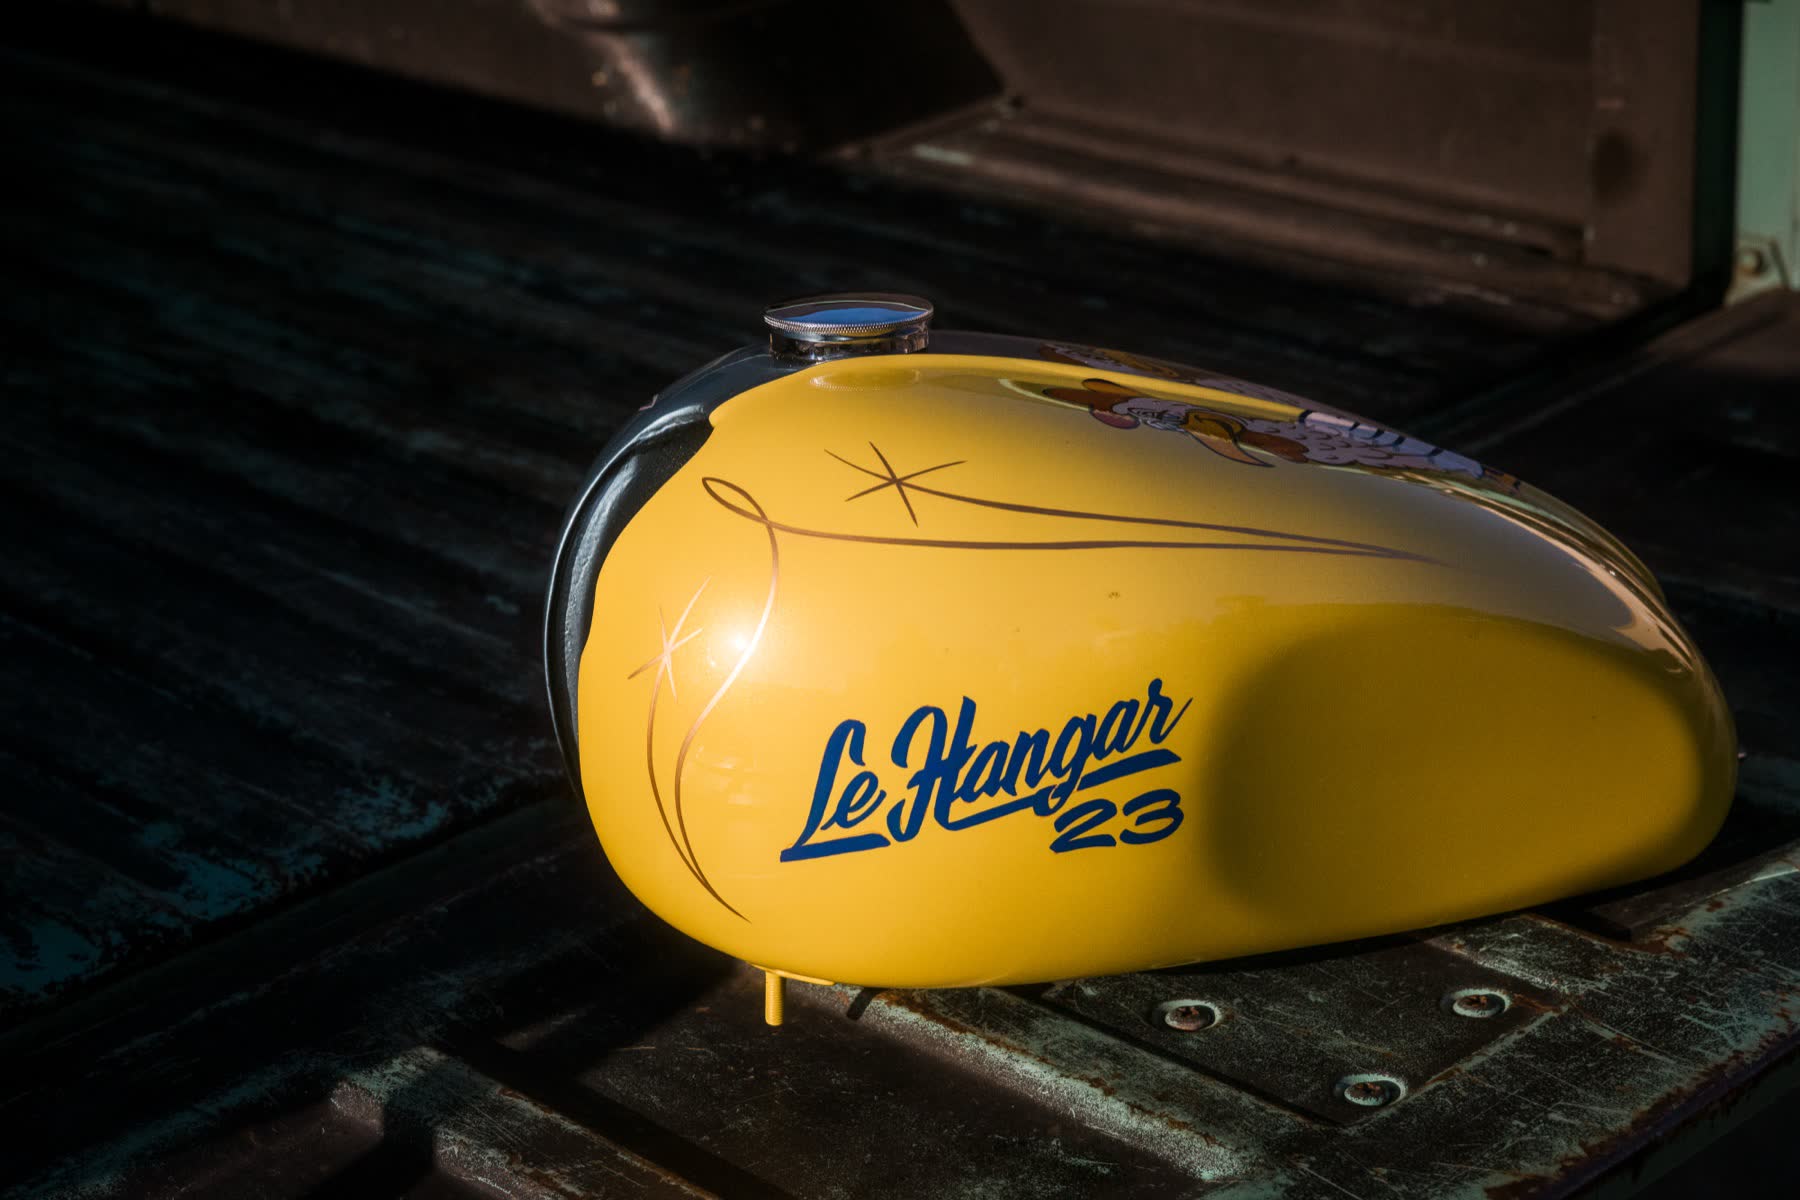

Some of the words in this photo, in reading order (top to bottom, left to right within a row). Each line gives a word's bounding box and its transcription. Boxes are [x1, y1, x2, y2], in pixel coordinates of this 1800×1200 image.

[779, 719, 890, 862] Le
[886, 678, 1193, 842] Hangar
[1049, 788, 1185, 854] 23
